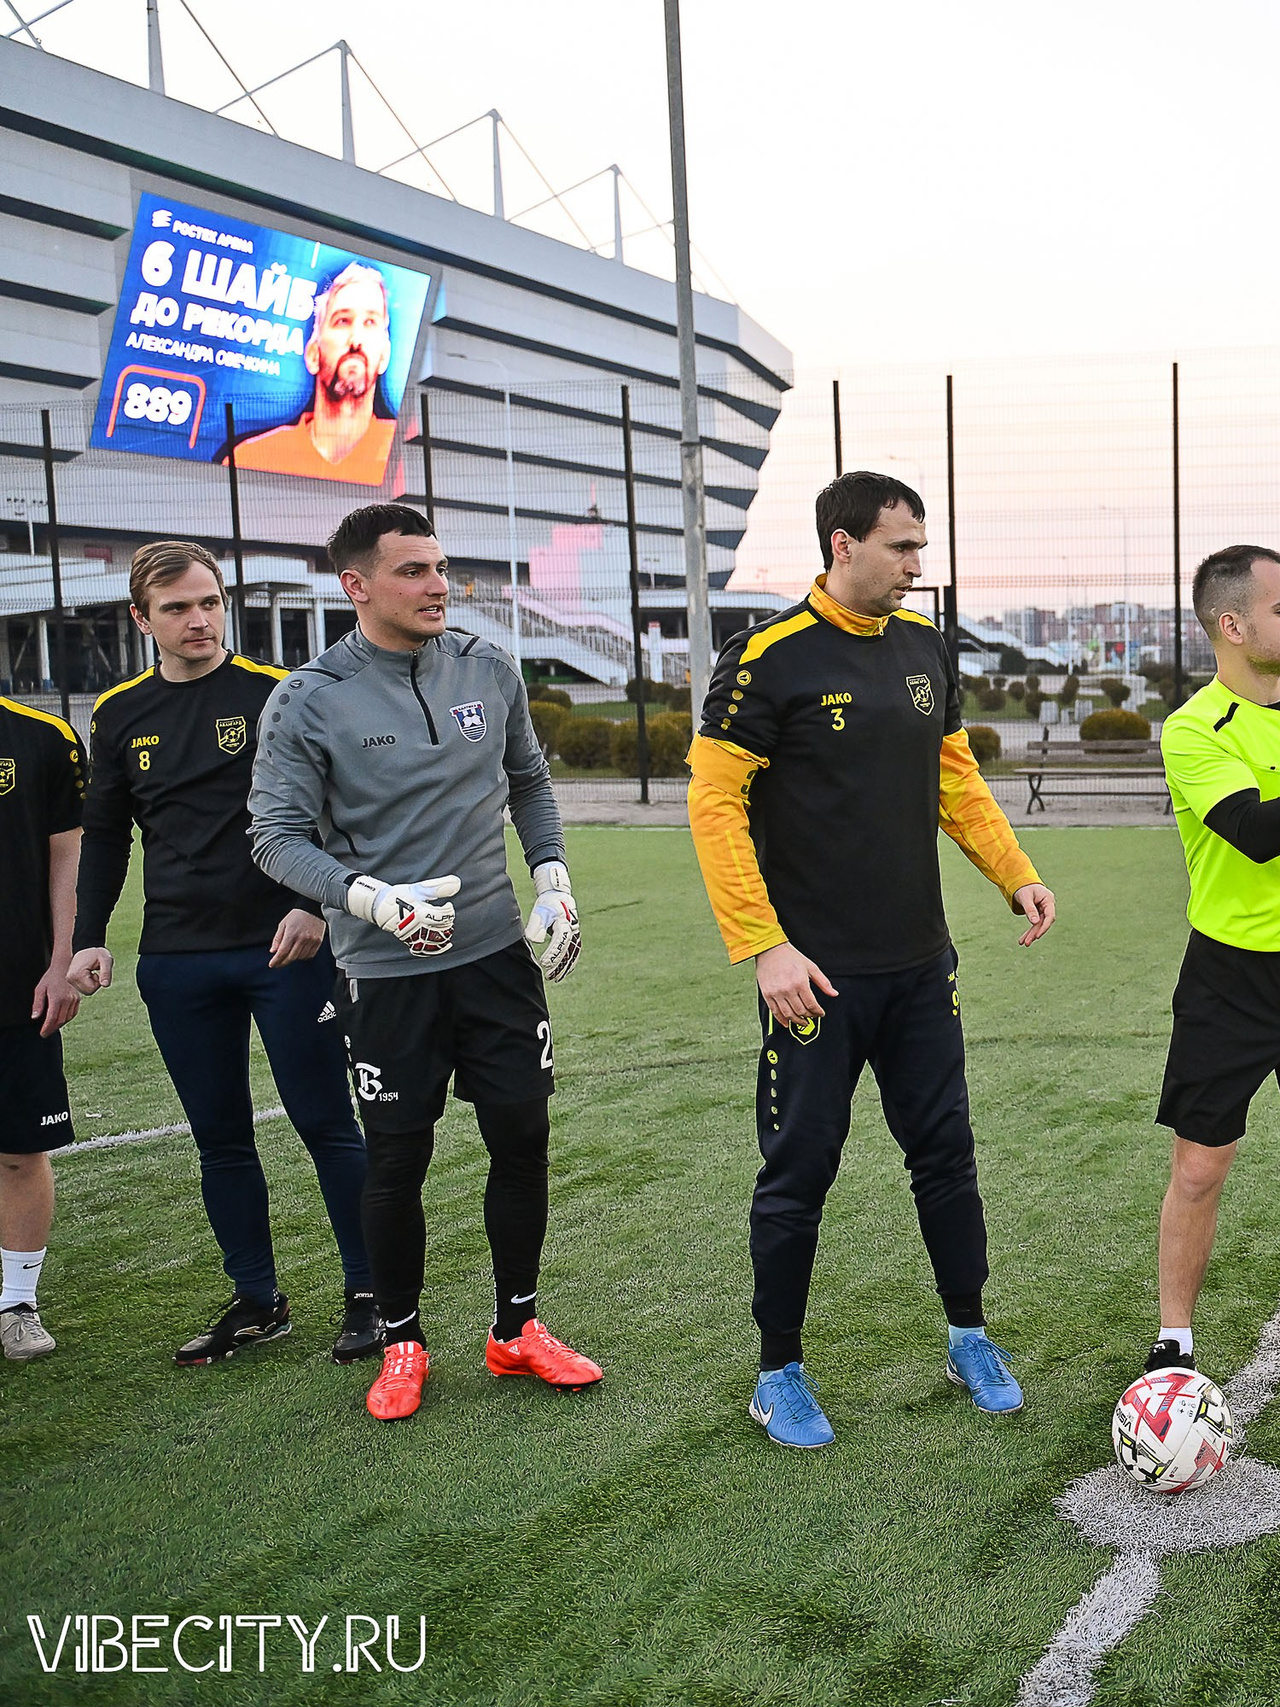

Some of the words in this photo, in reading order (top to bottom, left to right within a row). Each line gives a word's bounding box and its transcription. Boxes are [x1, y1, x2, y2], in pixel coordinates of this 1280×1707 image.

[141, 240, 175, 287] 6
[181, 249, 317, 321] ШАЙБ
[130, 291, 179, 328] ДО
[182, 302, 303, 356] РЕКОРДА
[125, 331, 214, 364] АЛЕКСАНДРА
[124, 383, 192, 425] 889
[821, 692, 853, 707] JAKO
[830, 708, 846, 731] 3
[131, 735, 160, 748] JAKO
[361, 735, 396, 749] JAKO
[138, 750, 151, 771] 8
[425, 913, 455, 922] ALPH
[549, 931, 569, 964] ALPHA
[536, 1020, 553, 1070] 2
[379, 1091, 399, 1102] 1954
[40, 1111, 69, 1126] JAKO
